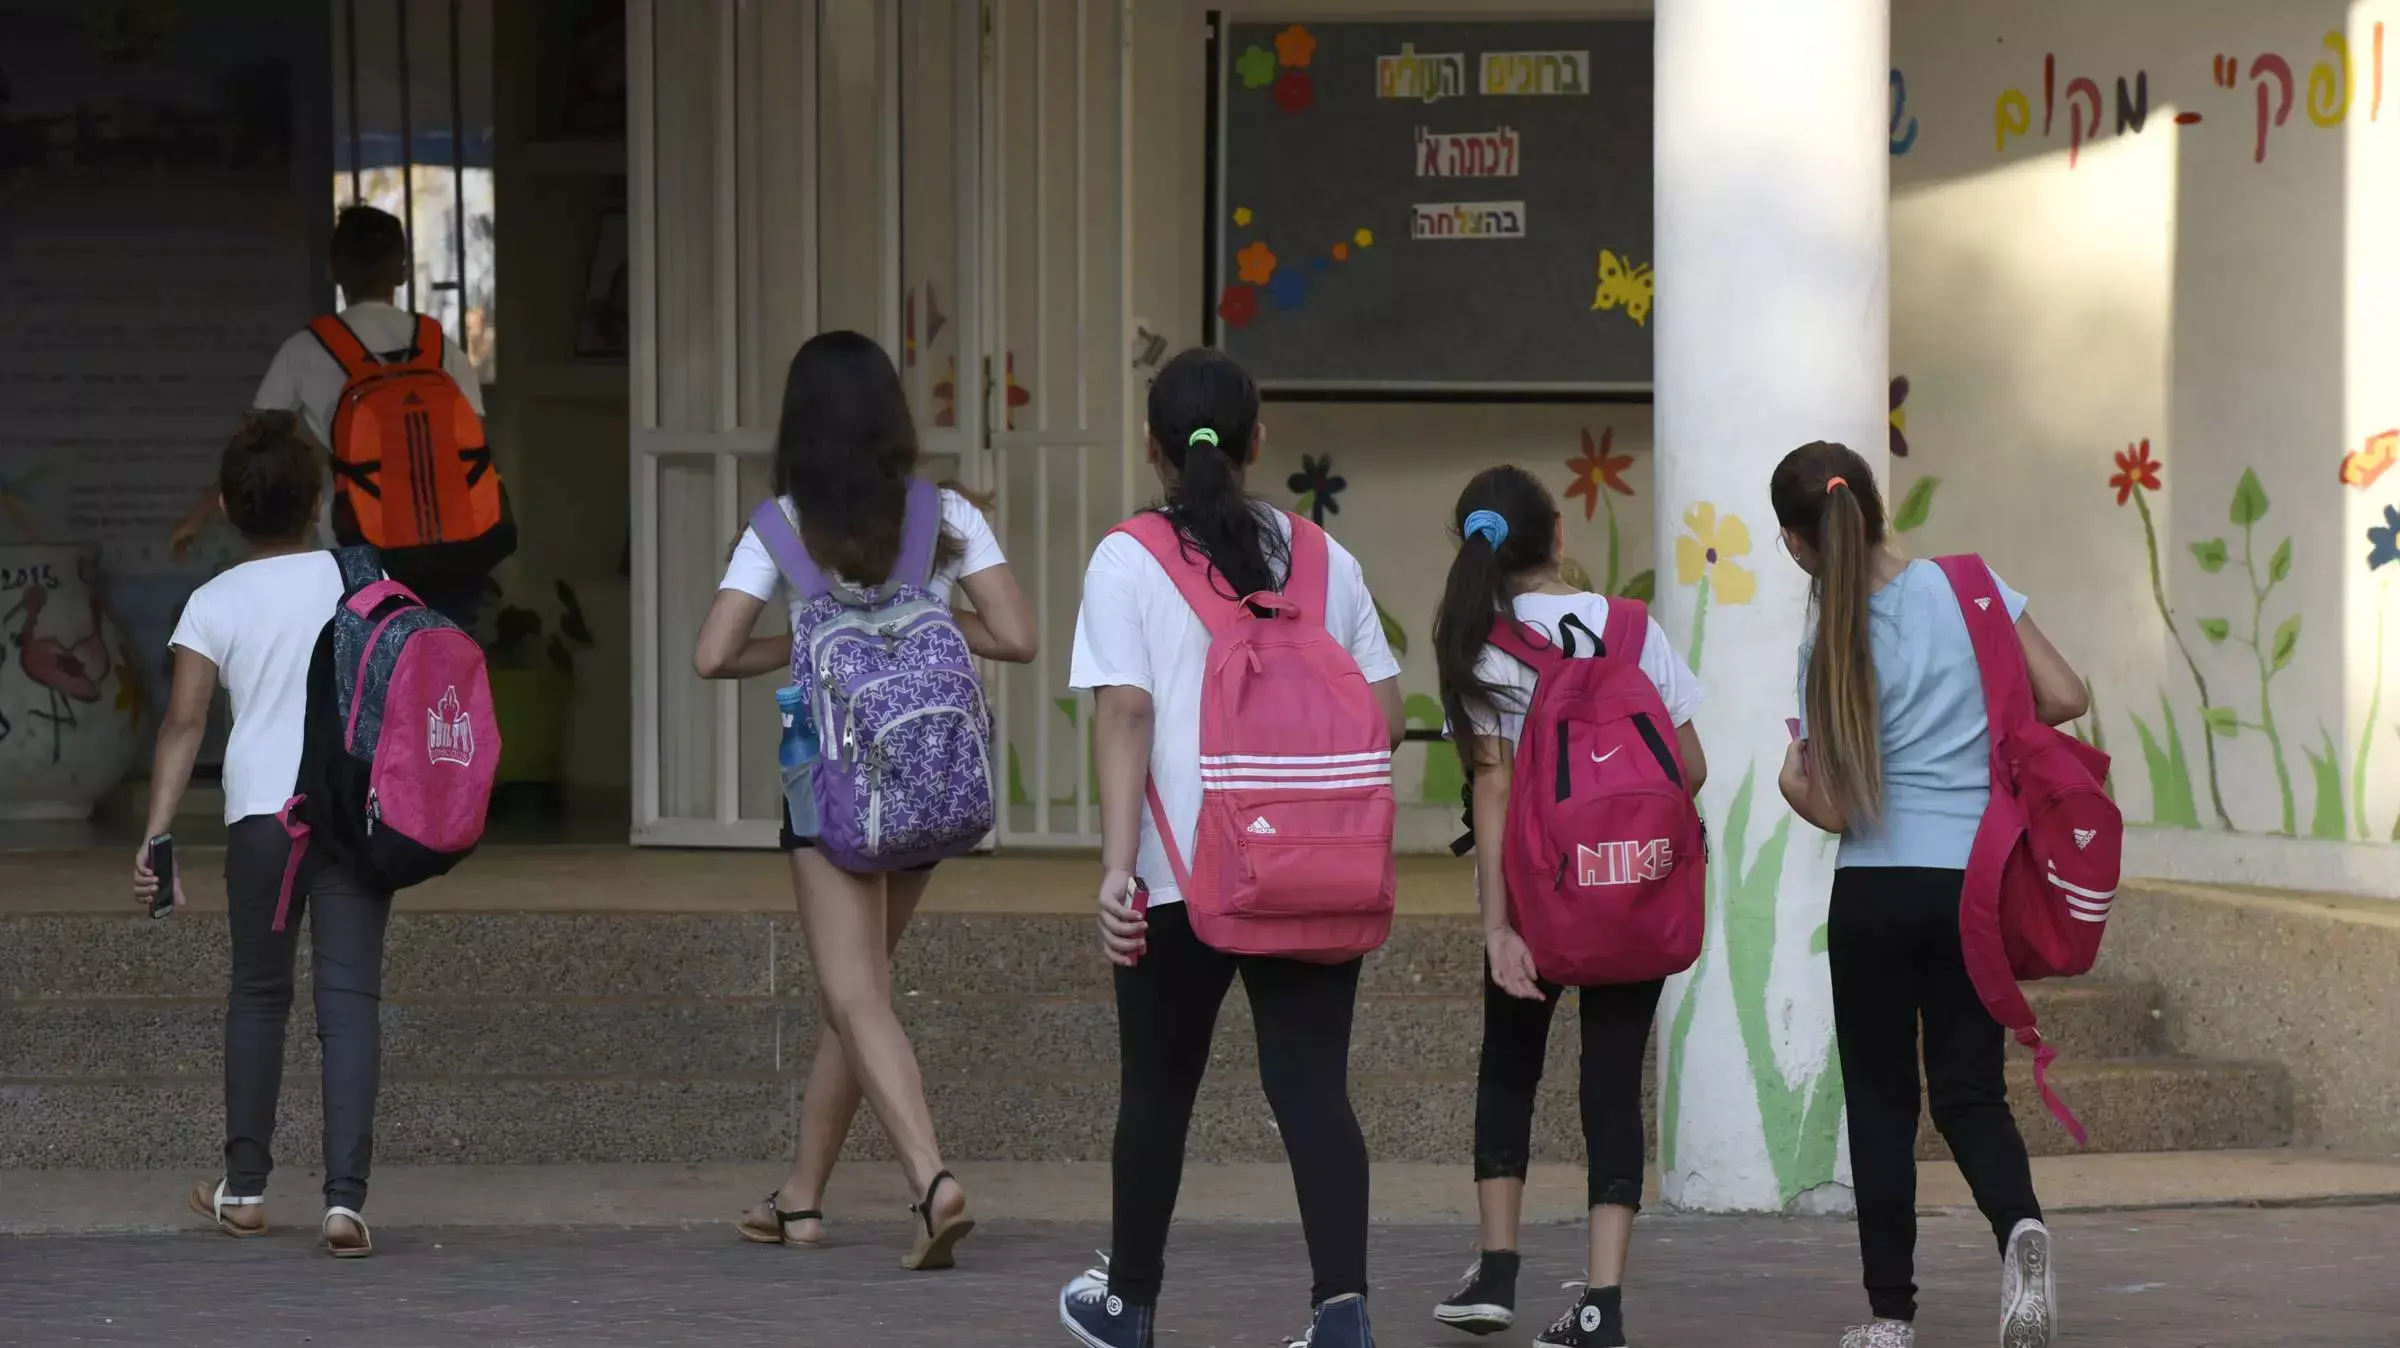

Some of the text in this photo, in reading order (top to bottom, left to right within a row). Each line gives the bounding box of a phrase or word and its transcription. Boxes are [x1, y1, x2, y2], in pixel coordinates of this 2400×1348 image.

[1379, 44, 1582, 100] ברוכים העולים
[1995, 52, 2147, 170] מקום
[1449, 127, 1514, 176] לכתה
[1, 563, 60, 591] 2015
[429, 716, 470, 753] GUILTY
[1577, 838, 1673, 886] NIKE
